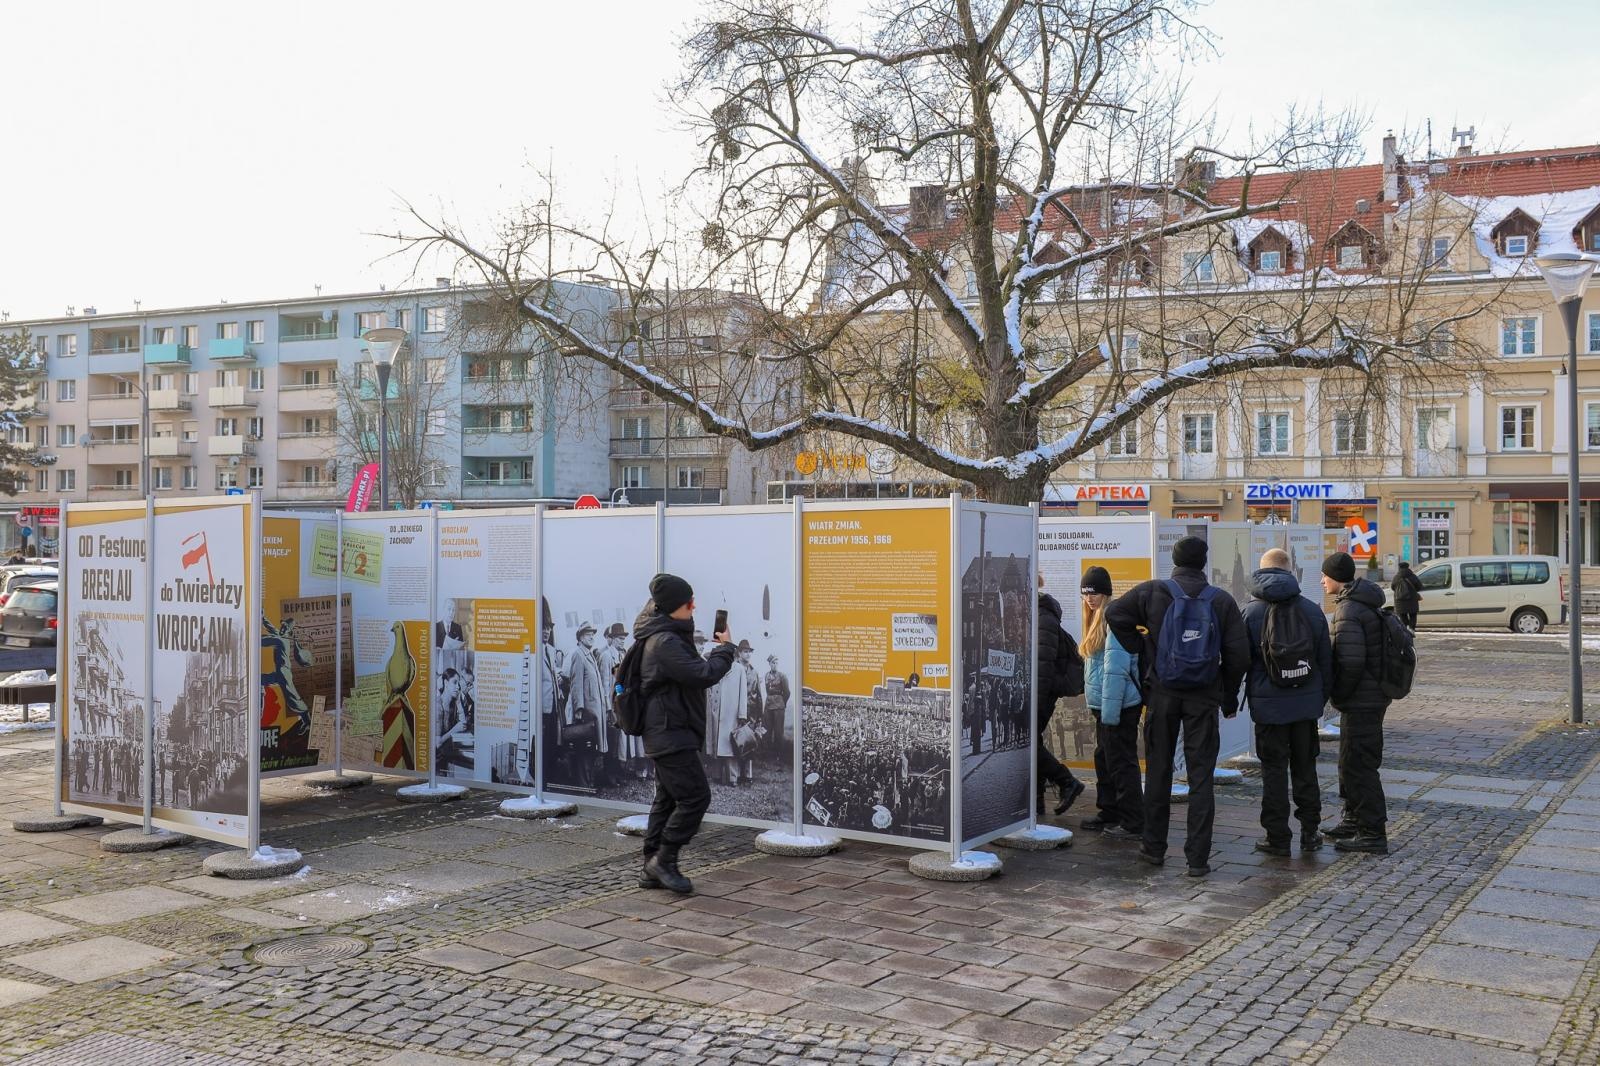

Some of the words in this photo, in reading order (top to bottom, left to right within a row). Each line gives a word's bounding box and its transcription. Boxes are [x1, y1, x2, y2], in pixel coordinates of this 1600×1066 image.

[1076, 486, 1147, 499] APTEKA
[1247, 484, 1333, 498] ZDROWIT
[441, 526, 469, 535] WROCŁAW
[809, 521, 833, 530] WIATR
[835, 521, 862, 530] ZMIAN.
[263, 536, 283, 545] EKIEM
[809, 535, 848, 545] PRZEŁOMY
[851, 535, 871, 546] 1956,
[1039, 532, 1053, 540] OLNI
[1058, 532, 1094, 540] SOLIDARNI.
[79, 535, 94, 558] OD
[99, 534, 146, 562] Festung
[263, 548, 292, 558] YNĄCEJ”
[463, 550, 482, 558] POLSKI
[82, 568, 132, 602] BRESLAU
[161, 583, 173, 602] do
[175, 578, 243, 609] Twierdzy
[284, 600, 331, 613] REPERTUAR
[157, 613, 233, 655] WROCŁAW
[419, 663, 428, 682] DLA
[924, 667, 934, 675] TO
[936, 667, 948, 675] MY!
[1282, 667, 1308, 678] PUMA
[419, 685, 428, 720] POLSKI
[260, 728, 279, 748] URĘ
[419, 731, 428, 770] EUROPY
